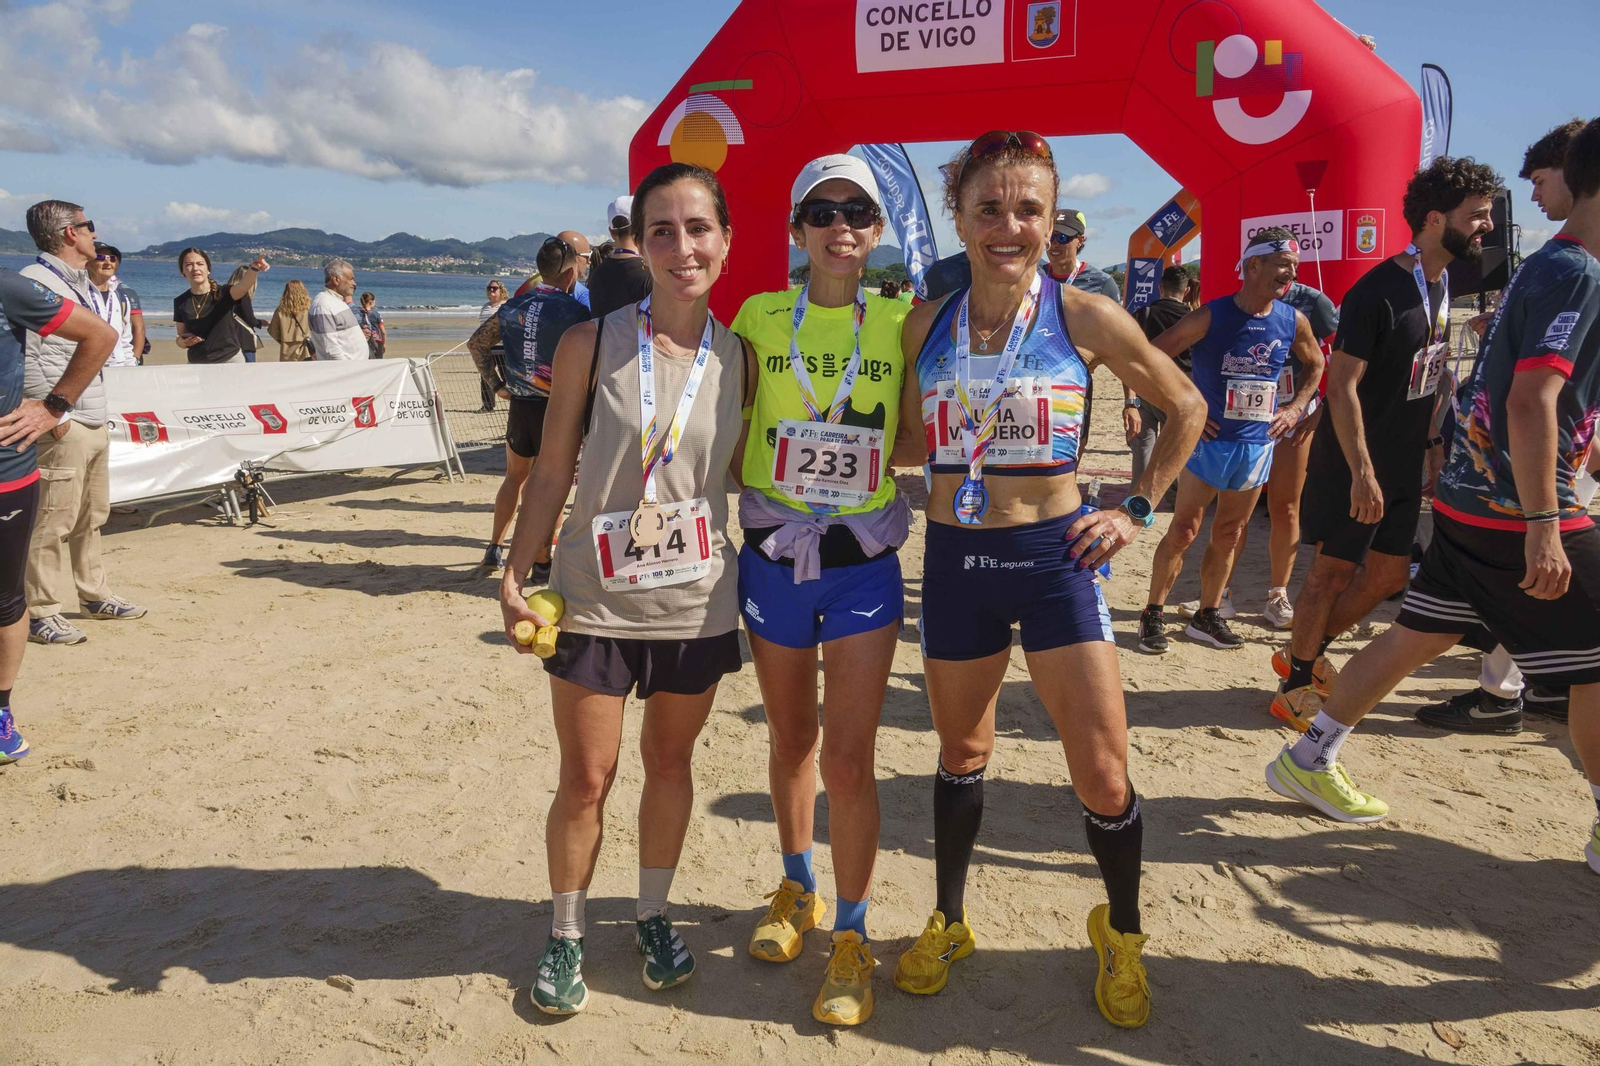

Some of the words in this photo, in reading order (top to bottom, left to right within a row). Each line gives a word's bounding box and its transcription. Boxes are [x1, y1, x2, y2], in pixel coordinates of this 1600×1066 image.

[866, 0, 992, 26] CONCELLO
[880, 31, 910, 52] DE
[918, 25, 976, 49] VIGO
[1162, 211, 1180, 227] FE
[1248, 222, 1334, 240] COELLO
[1300, 238, 1322, 250] GO
[1134, 280, 1154, 302] FE
[524, 302, 539, 339] CARREIRA
[1006, 326, 1021, 351] CARREIRA
[524, 340, 532, 360] 100
[822, 353, 838, 378] que
[842, 357, 892, 382] auga
[1022, 354, 1044, 370] FE
[1246, 394, 1263, 407] 19
[184, 412, 246, 424] CONCELLO
[299, 404, 346, 416] CONCELLO
[397, 411, 408, 419] DE
[410, 410, 431, 418] VIGO
[217, 422, 246, 430] VIGO
[308, 416, 319, 425] DE
[323, 415, 345, 424] VIGO
[820, 431, 847, 439] CARREIRA
[798, 448, 858, 478] 233
[978, 556, 998, 568] FE
[1000, 561, 1034, 569] seguros
